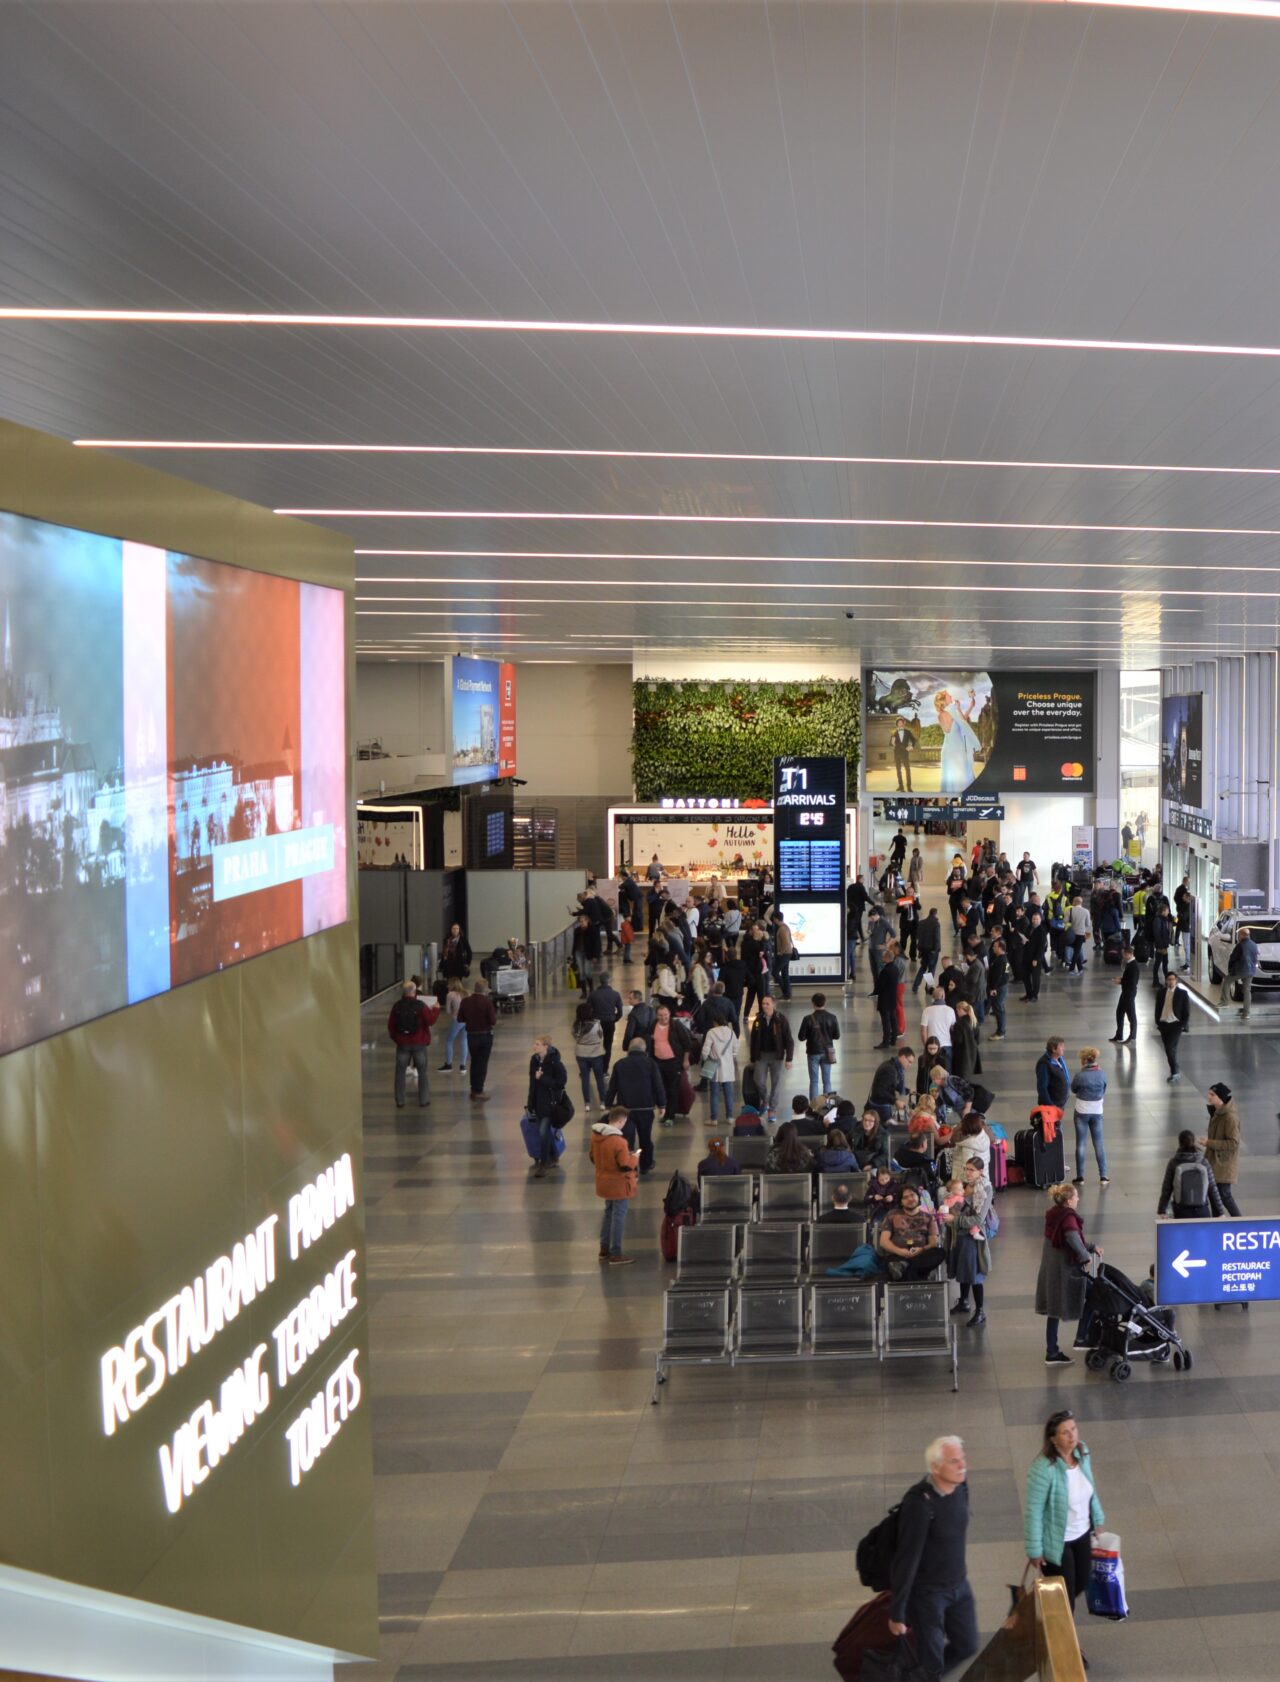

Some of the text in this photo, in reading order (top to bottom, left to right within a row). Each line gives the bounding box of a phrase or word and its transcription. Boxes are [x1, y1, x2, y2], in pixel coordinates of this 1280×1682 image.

[1053, 693, 1082, 702] Prague.
[1057, 701, 1082, 710] unique
[1046, 709, 1082, 717] everyday.
[781, 768, 807, 790] T1
[662, 798, 739, 808] MATTONI
[784, 794, 836, 805] ARRIVALS
[726, 826, 755, 838] Hello
[724, 839, 756, 847] AUTUMN
[223, 849, 270, 886] PRAHA
[1222, 1261, 1271, 1272] RESTAURACE
[1222, 1272, 1262, 1282] РЕСТОРАН
[1222, 1282, 1256, 1292] 레스토랑
[100, 1214, 278, 1435] RESTAURANT
[159, 1249, 358, 1513] VIEWING TERRACE
[285, 1348, 361, 1486] TOILETS
